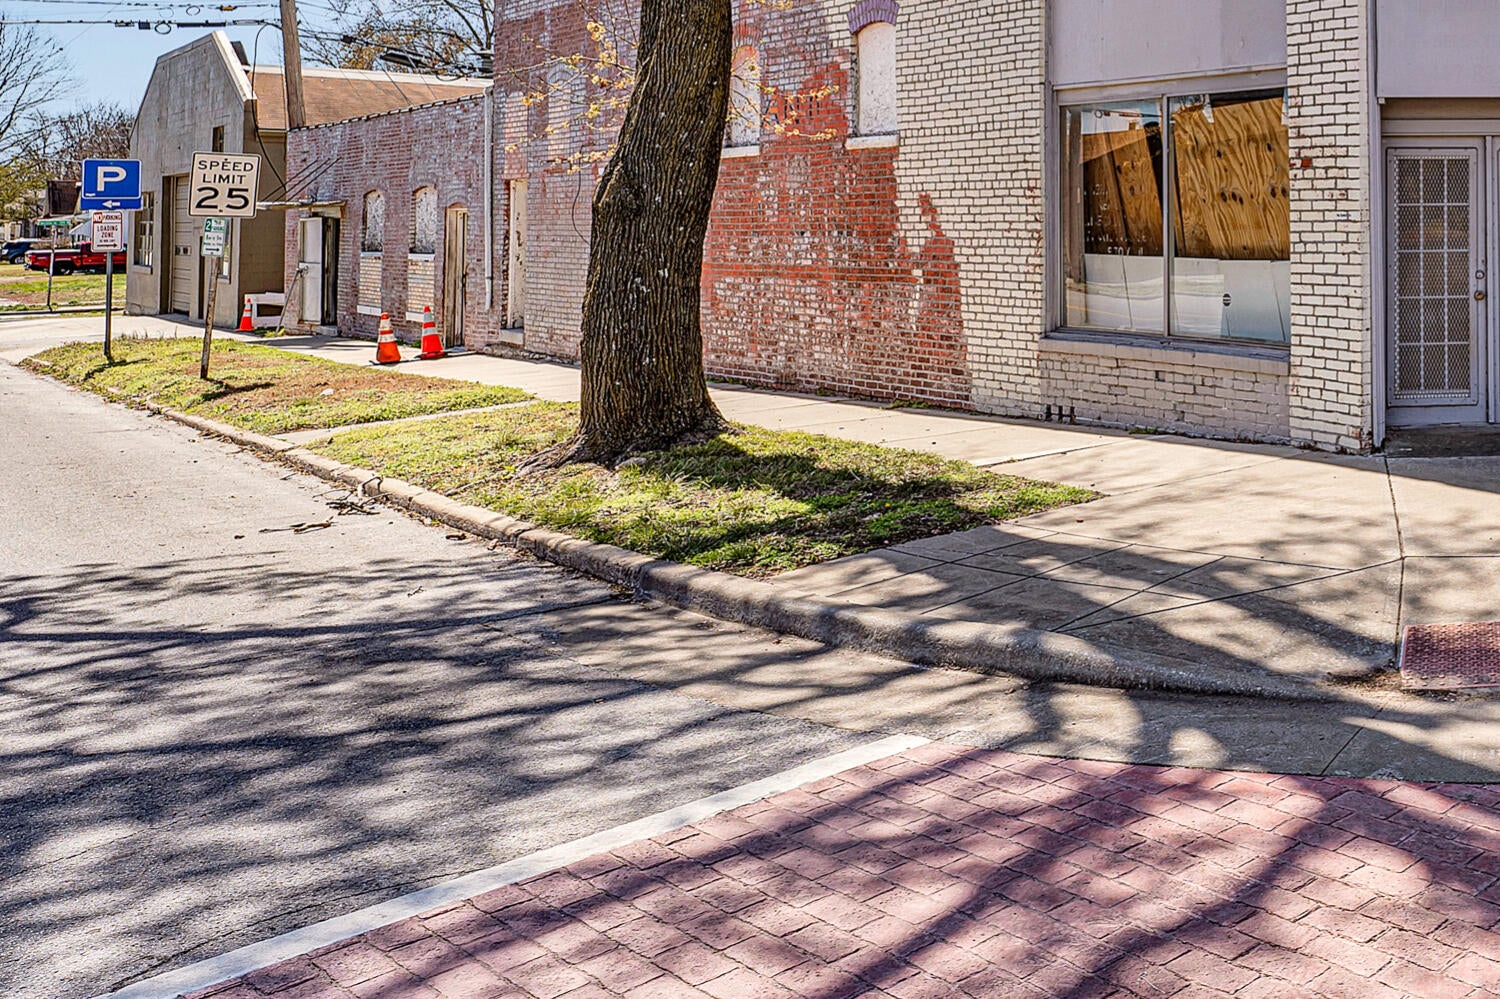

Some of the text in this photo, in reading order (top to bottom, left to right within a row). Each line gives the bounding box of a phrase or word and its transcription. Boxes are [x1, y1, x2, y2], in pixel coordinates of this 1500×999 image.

[198, 160, 254, 172] SPEED
[97, 166, 127, 191] P
[202, 174, 247, 184] LIMIT
[195, 187, 250, 210] 25
[93, 214, 103, 222] NO
[205, 220, 212, 230] 2
